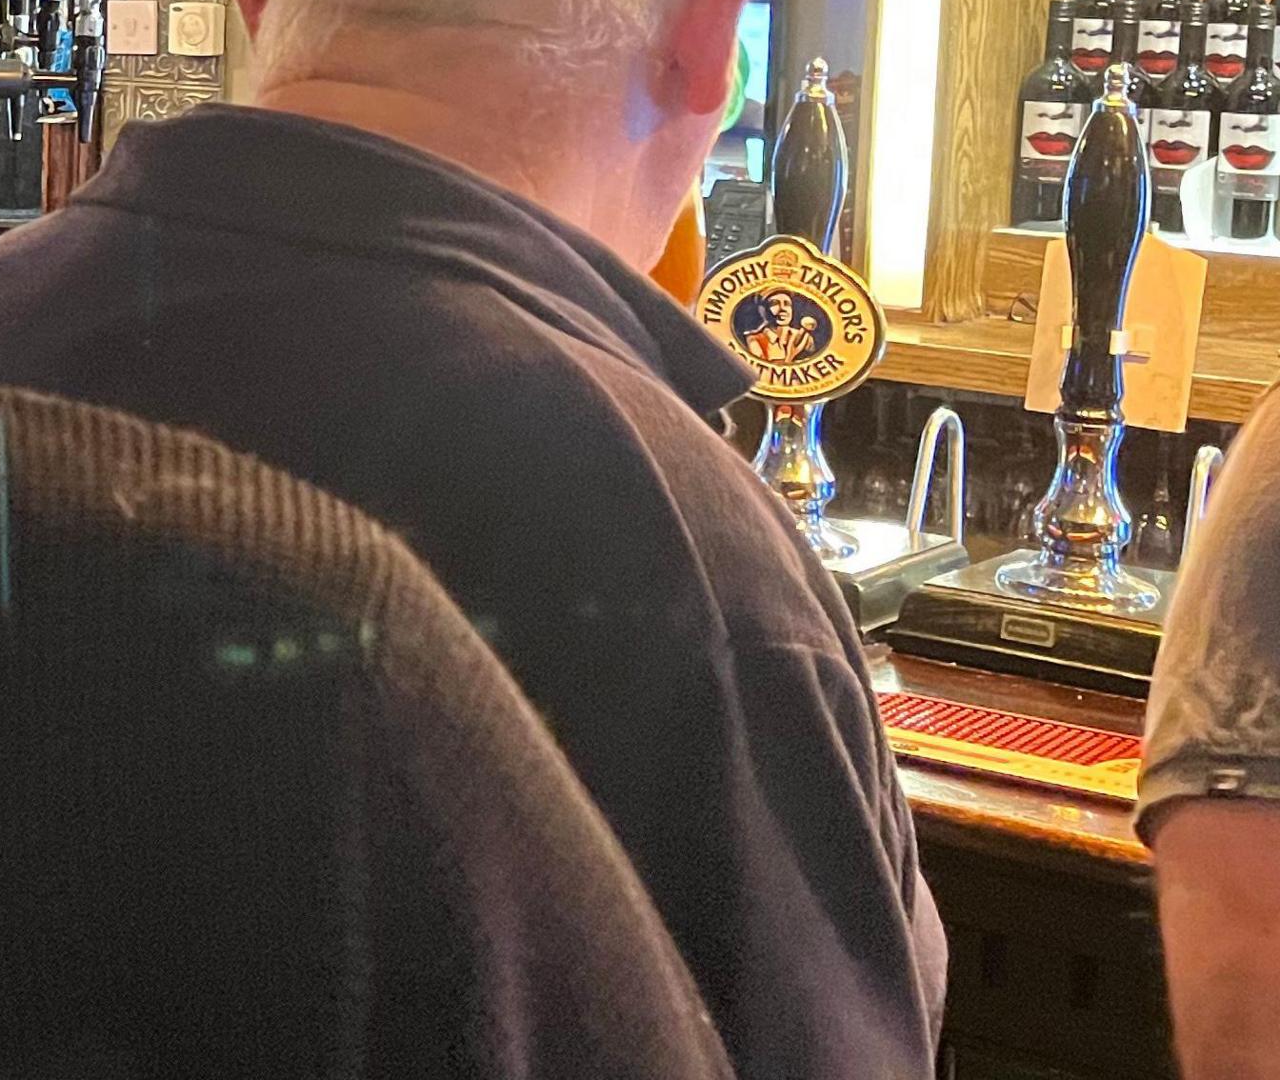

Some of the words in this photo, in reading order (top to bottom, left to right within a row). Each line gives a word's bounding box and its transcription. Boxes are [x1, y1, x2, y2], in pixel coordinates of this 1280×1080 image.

[703, 260, 769, 325] TIMOTHY
[799, 264, 868, 345] TAYLOR'S
[728, 340, 844, 387] TMAKER
